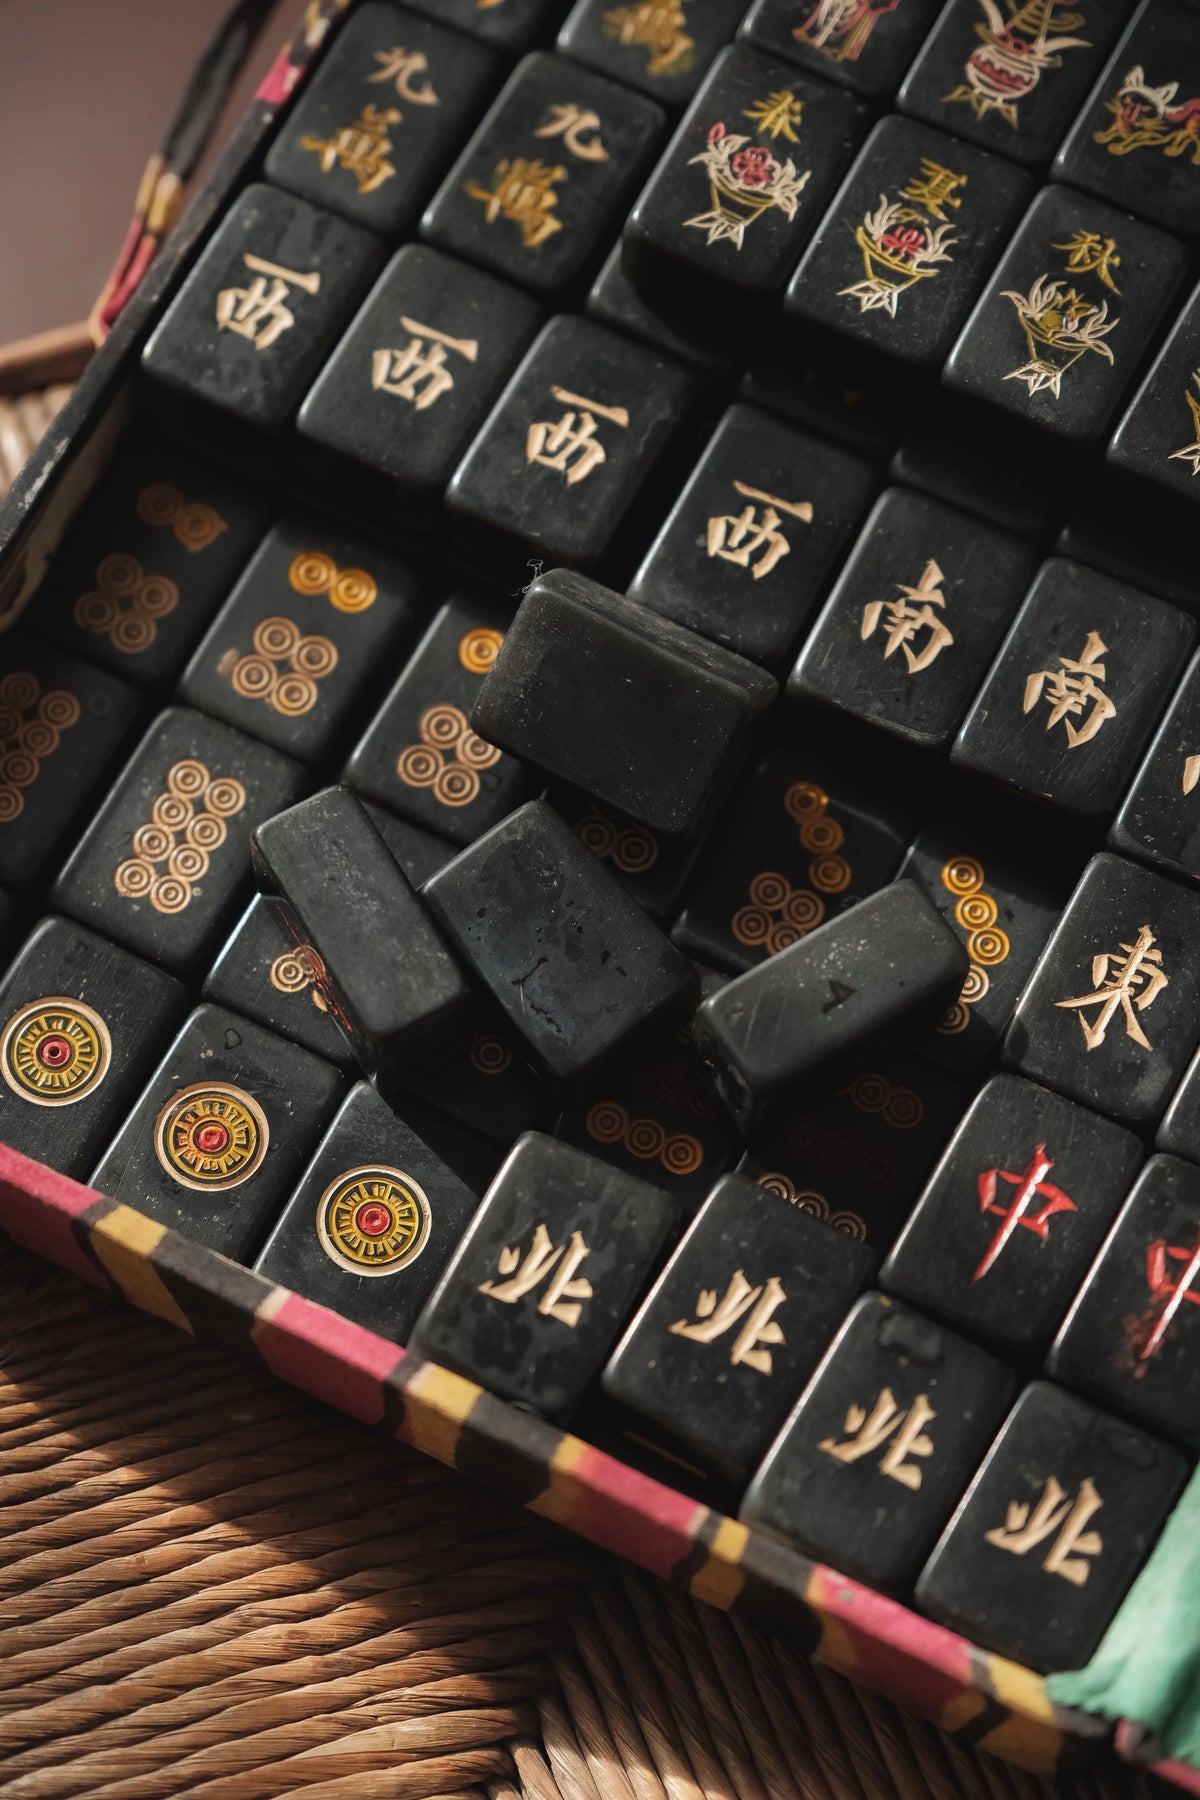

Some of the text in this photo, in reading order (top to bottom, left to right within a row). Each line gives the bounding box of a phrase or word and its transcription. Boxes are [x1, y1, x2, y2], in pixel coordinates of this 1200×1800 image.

[302, 46, 439, 194] 九萬
[465, 103, 609, 248] 九萬
[215, 253, 320, 350] 西
[1051, 228, 1122, 296] 秋
[371, 316, 477, 410] 西
[526, 385, 629, 485] 西
[706, 480, 813, 580] 西
[860, 559, 954, 674] 南
[1023, 630, 1116, 749] 南
[1055, 924, 1169, 1051] 東
[974, 1142, 1078, 1281] 中
[478, 1223, 593, 1328] 北
[669, 1269, 787, 1375] 北
[818, 1387, 936, 1489] 北
[985, 1477, 1103, 1585] 北
